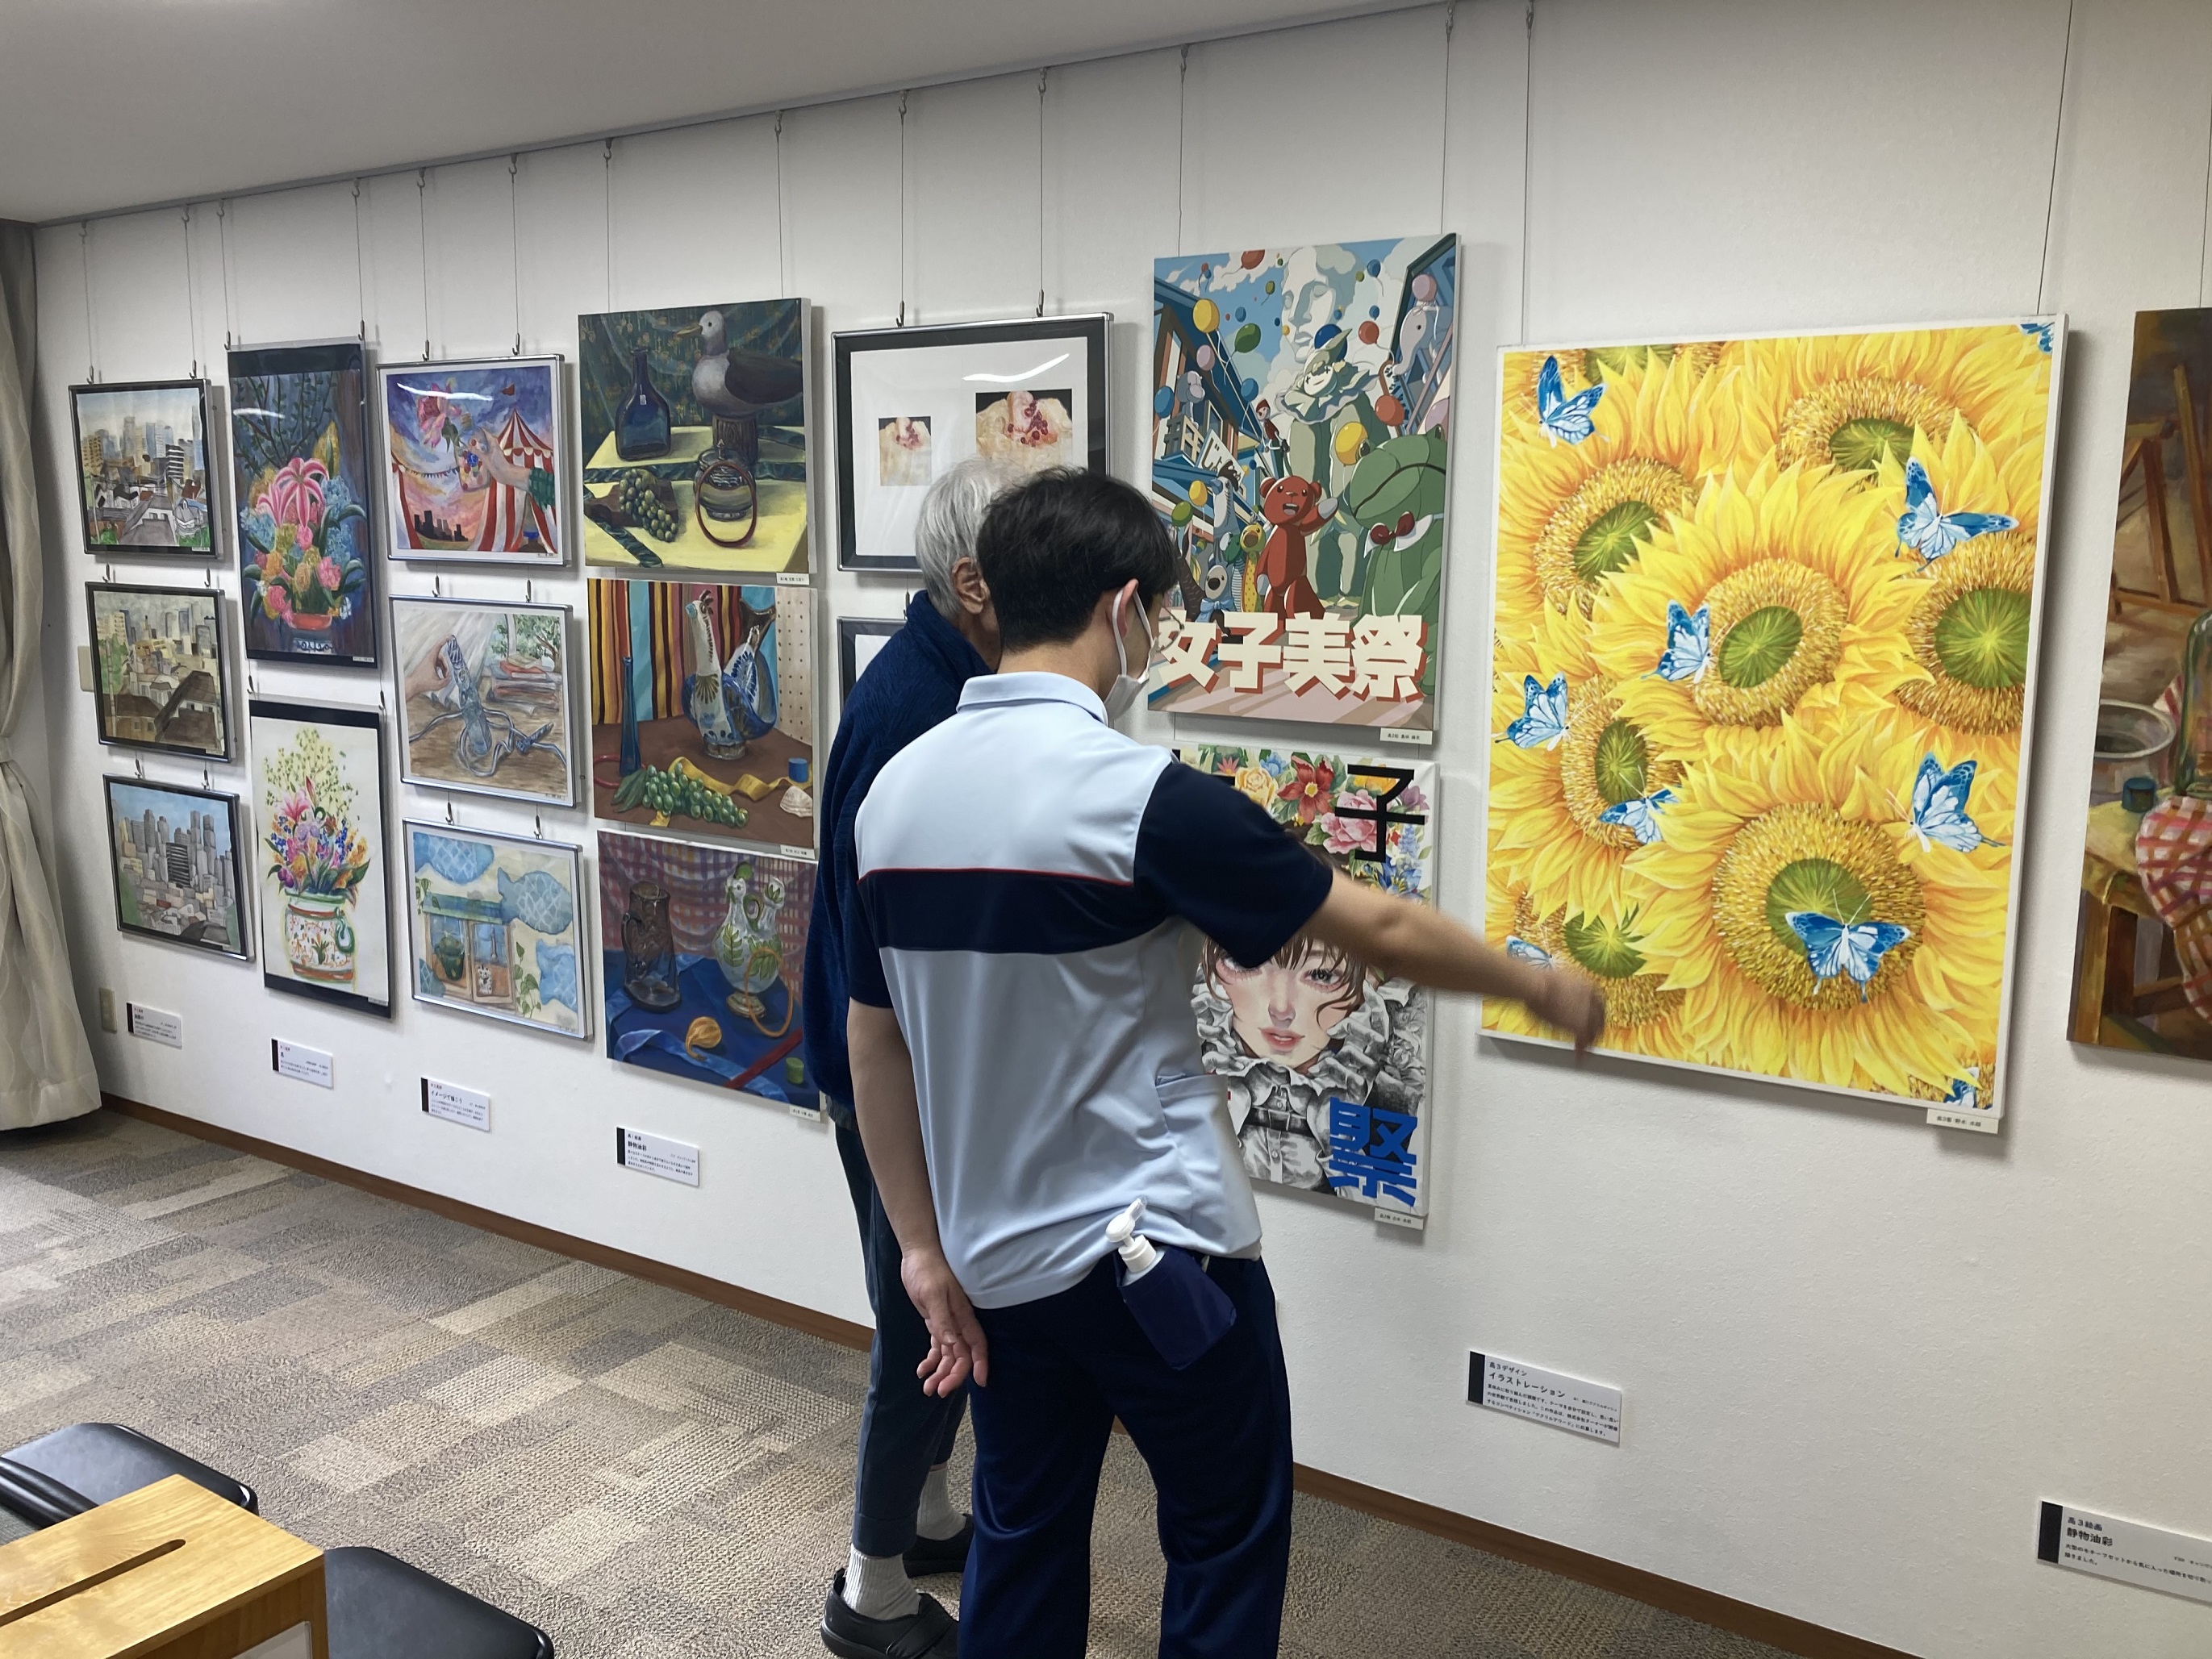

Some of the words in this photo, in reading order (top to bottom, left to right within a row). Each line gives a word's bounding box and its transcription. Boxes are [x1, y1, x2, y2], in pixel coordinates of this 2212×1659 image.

[1158, 609, 1425, 700] 女子美祭
[1489, 1371, 1564, 1398] イラストレーション
[2067, 1527, 2112, 1547] 静物油彩
